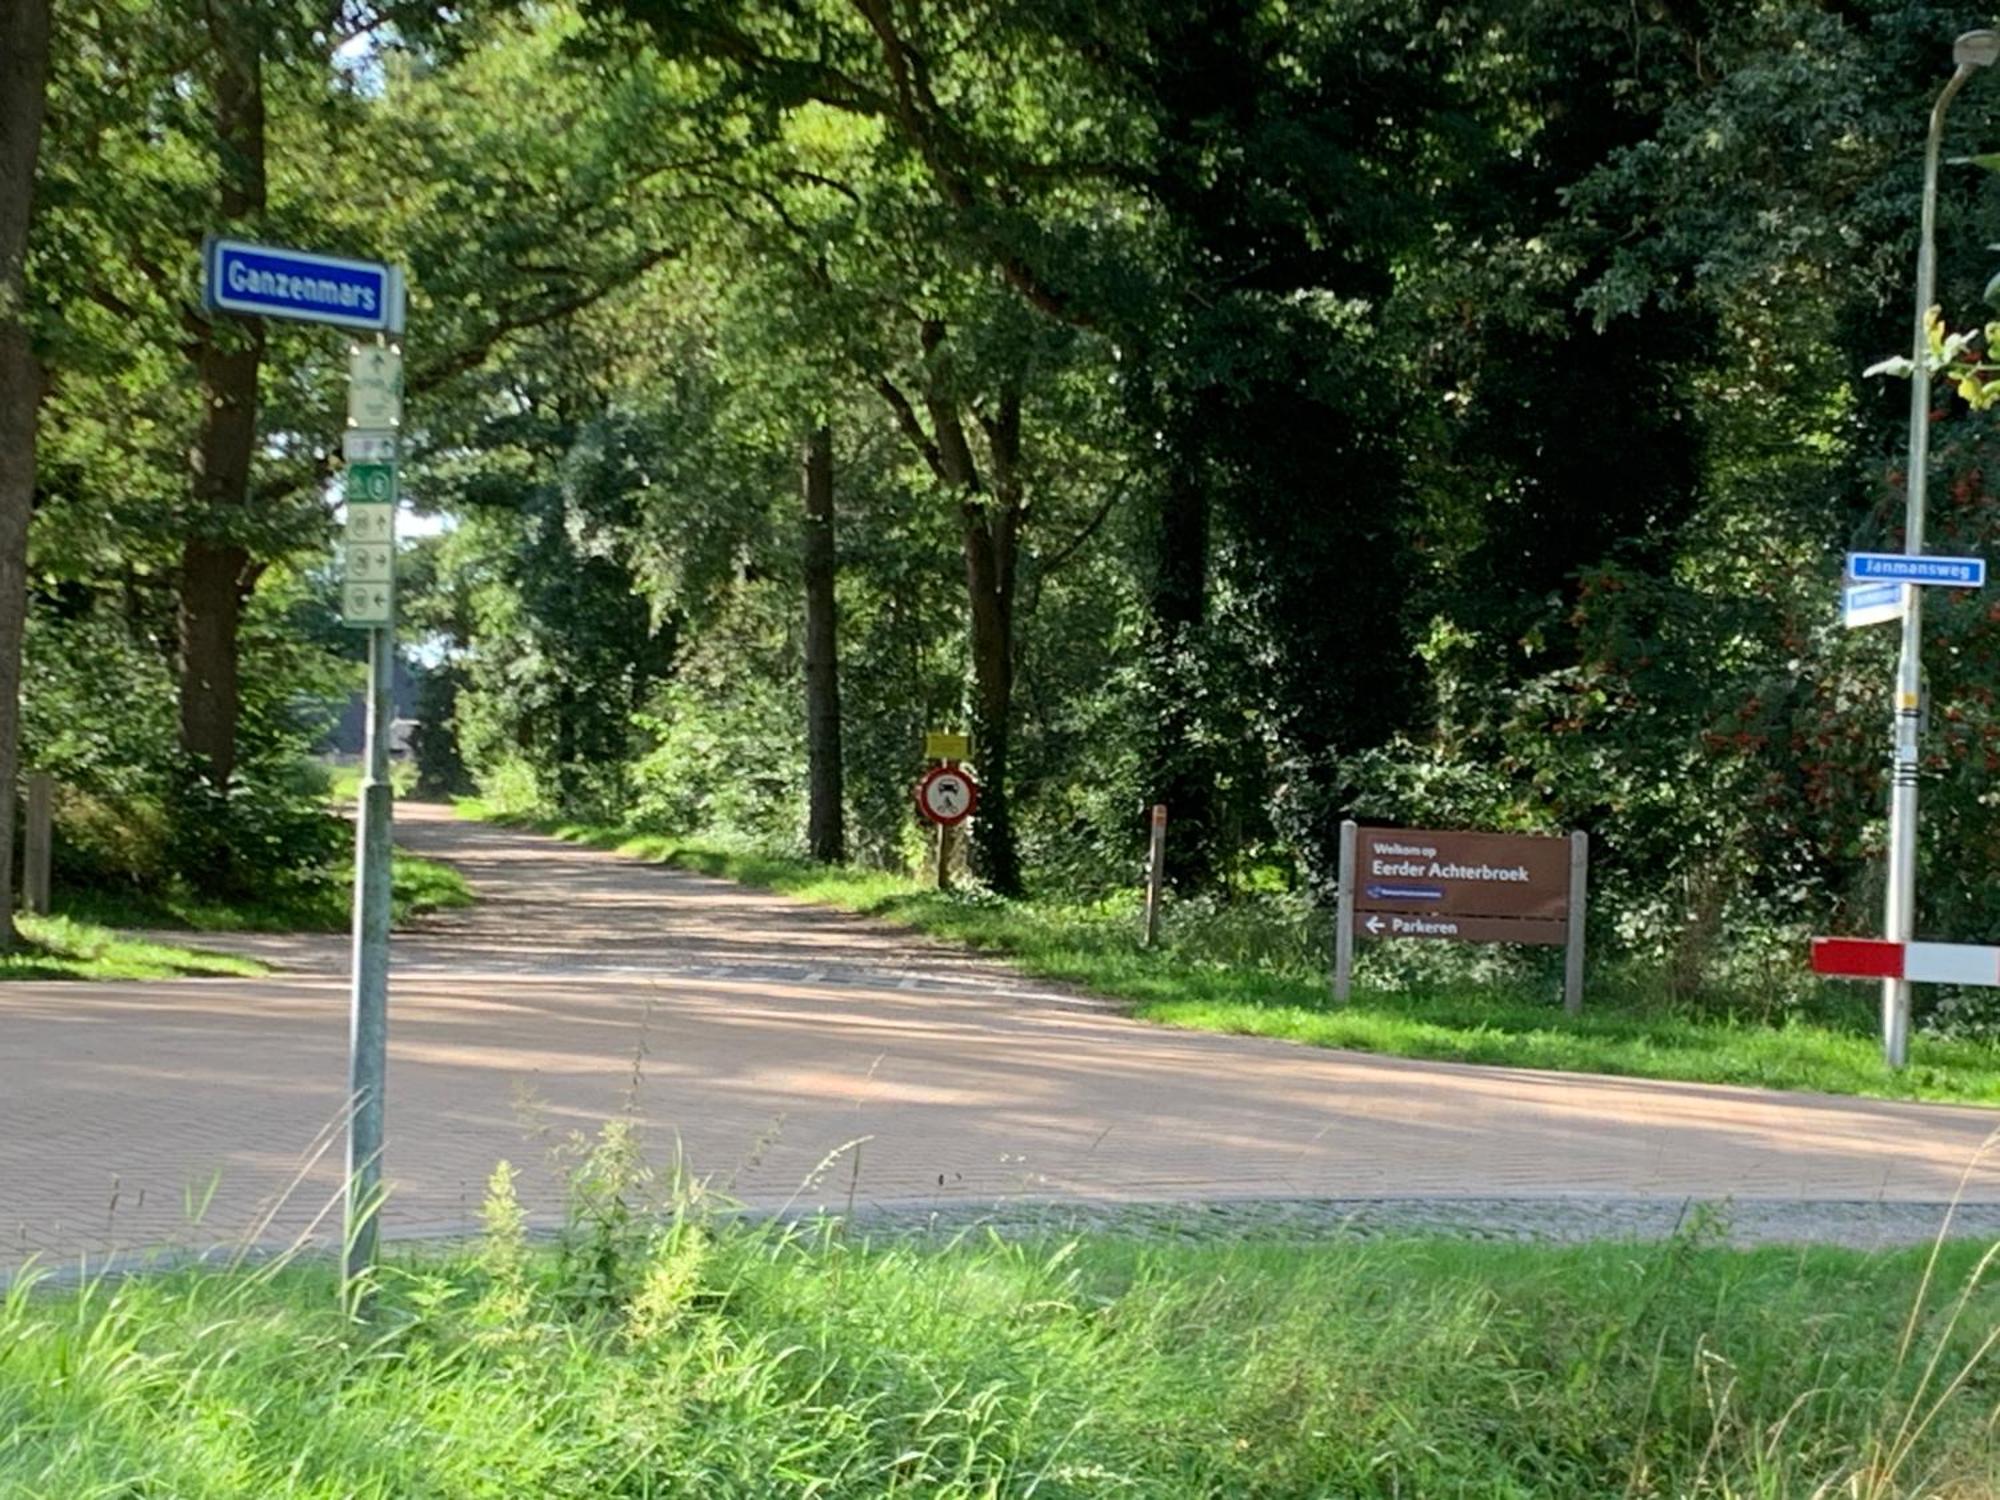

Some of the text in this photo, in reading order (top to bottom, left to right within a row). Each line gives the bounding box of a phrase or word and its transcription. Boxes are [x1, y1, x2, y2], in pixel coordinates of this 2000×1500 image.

[228, 260, 376, 311] Ganzenmars
[1865, 559, 1971, 581] Janmansweg
[1373, 843, 1437, 859] Welkom op
[1372, 860, 1529, 881] Eerder Achterbroek
[1392, 918, 1458, 934] Parkeren
